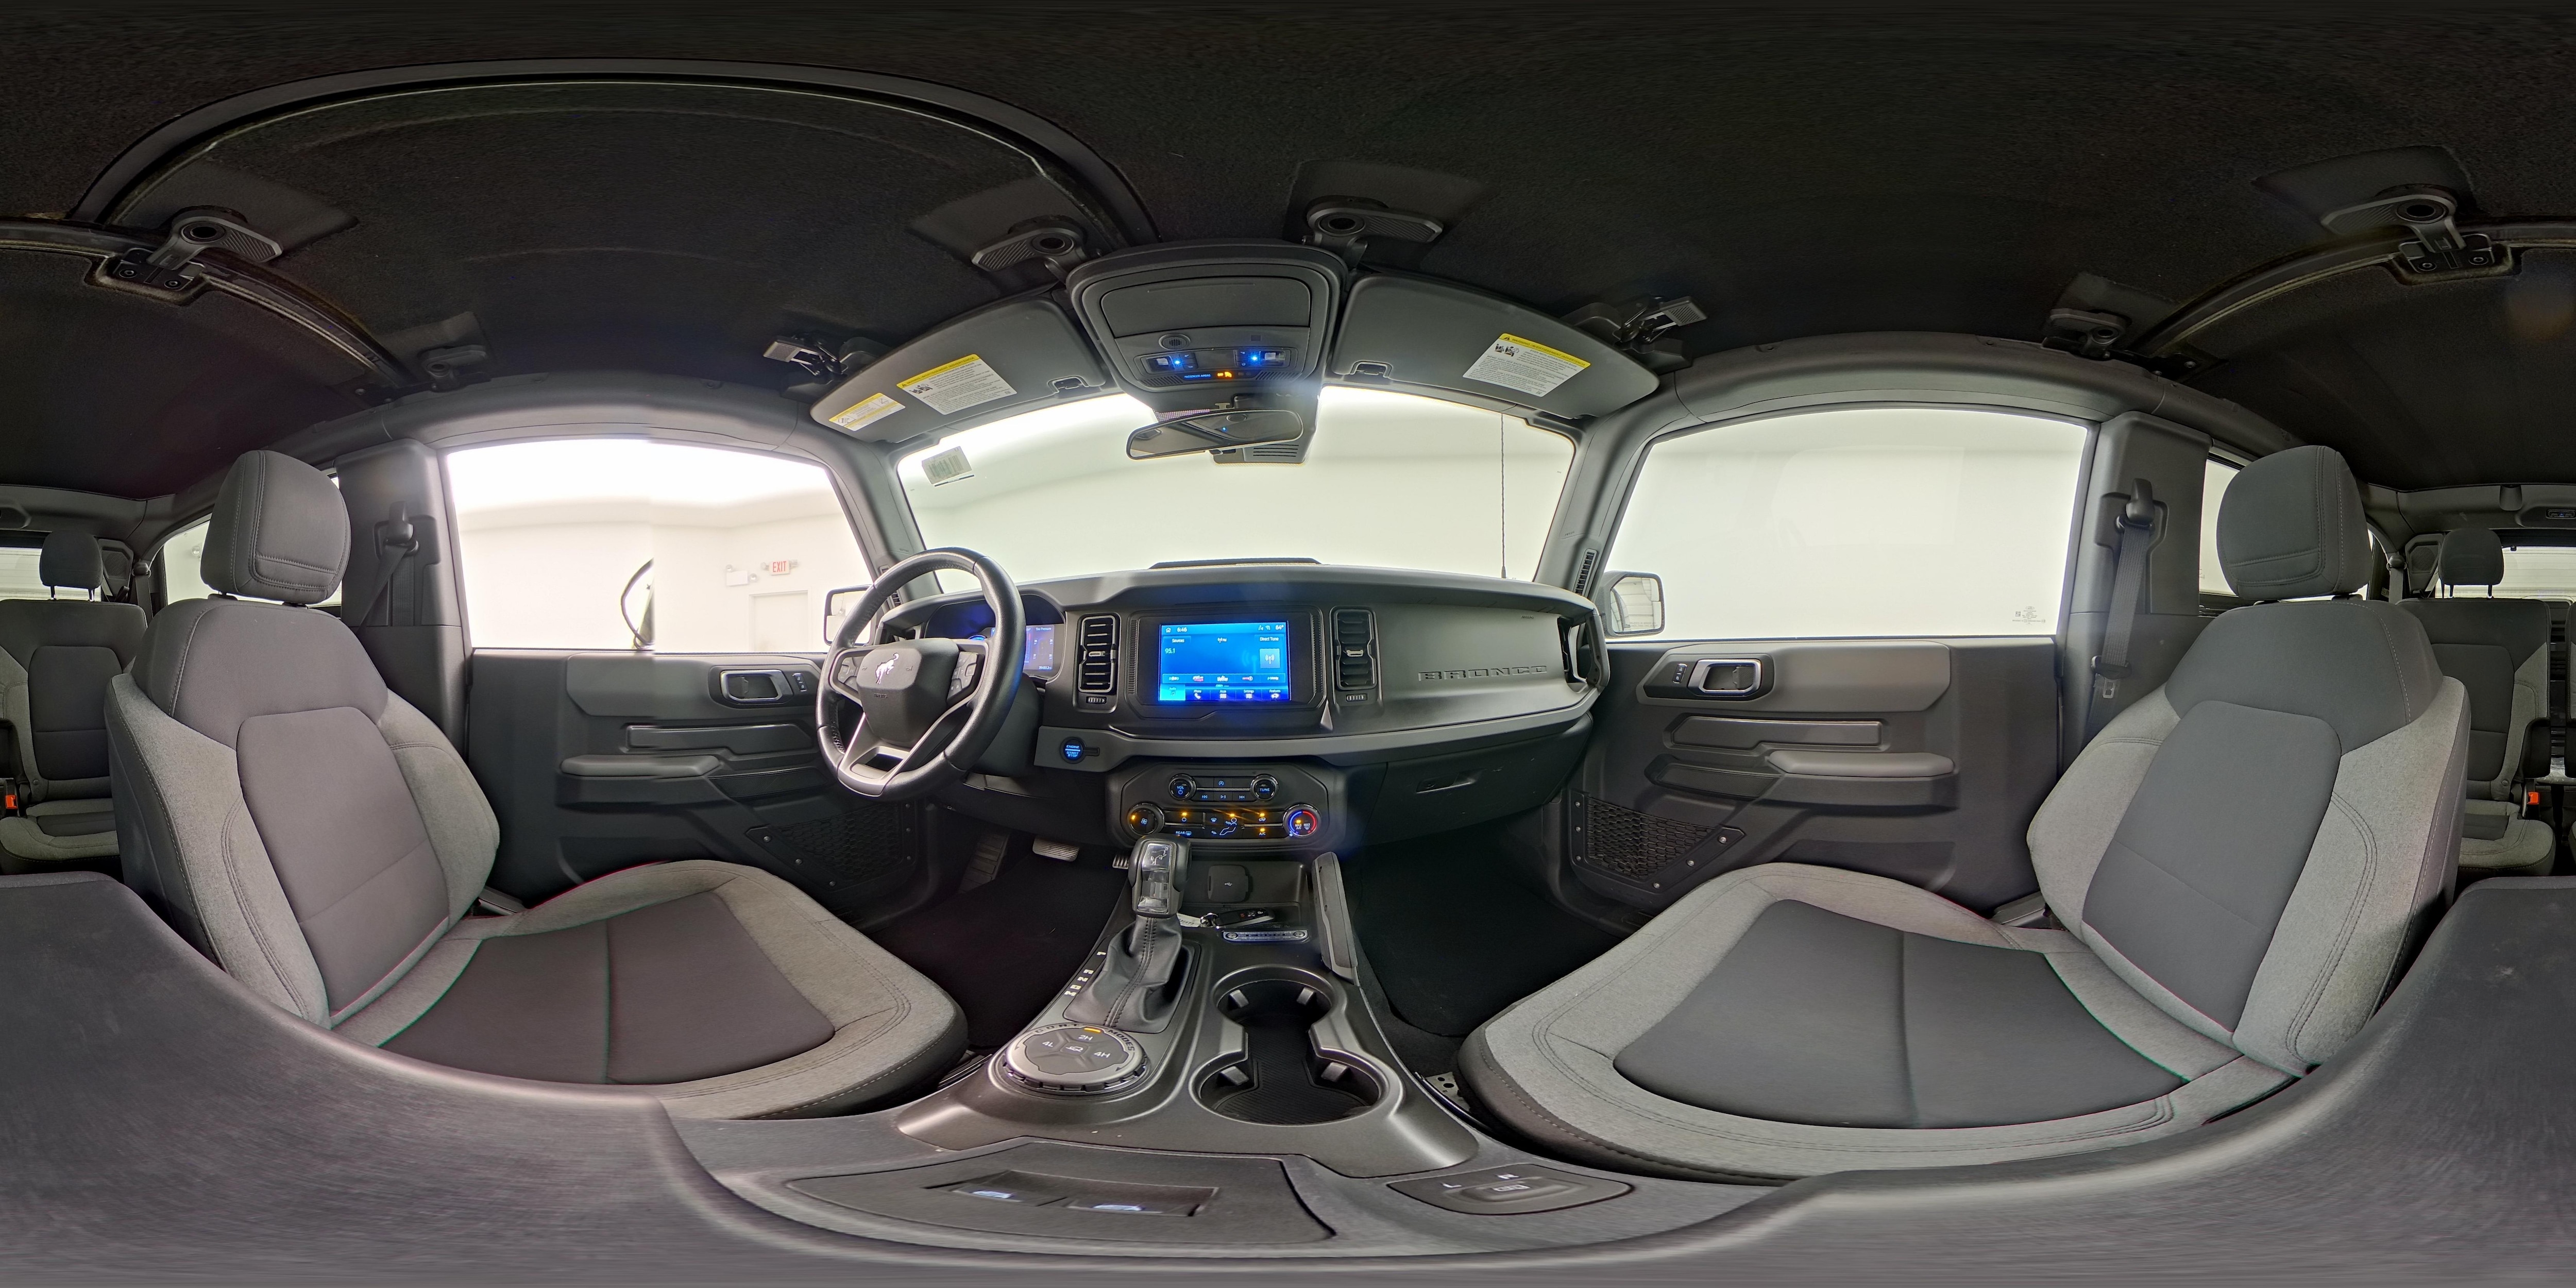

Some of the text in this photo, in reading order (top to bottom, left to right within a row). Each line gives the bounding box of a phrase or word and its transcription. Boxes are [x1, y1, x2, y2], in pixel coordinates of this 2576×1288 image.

[772, 561, 787, 572] EXIT
[1418, 665, 1547, 681] BRONCO
[1108, 1029, 1136, 1052] MODES
